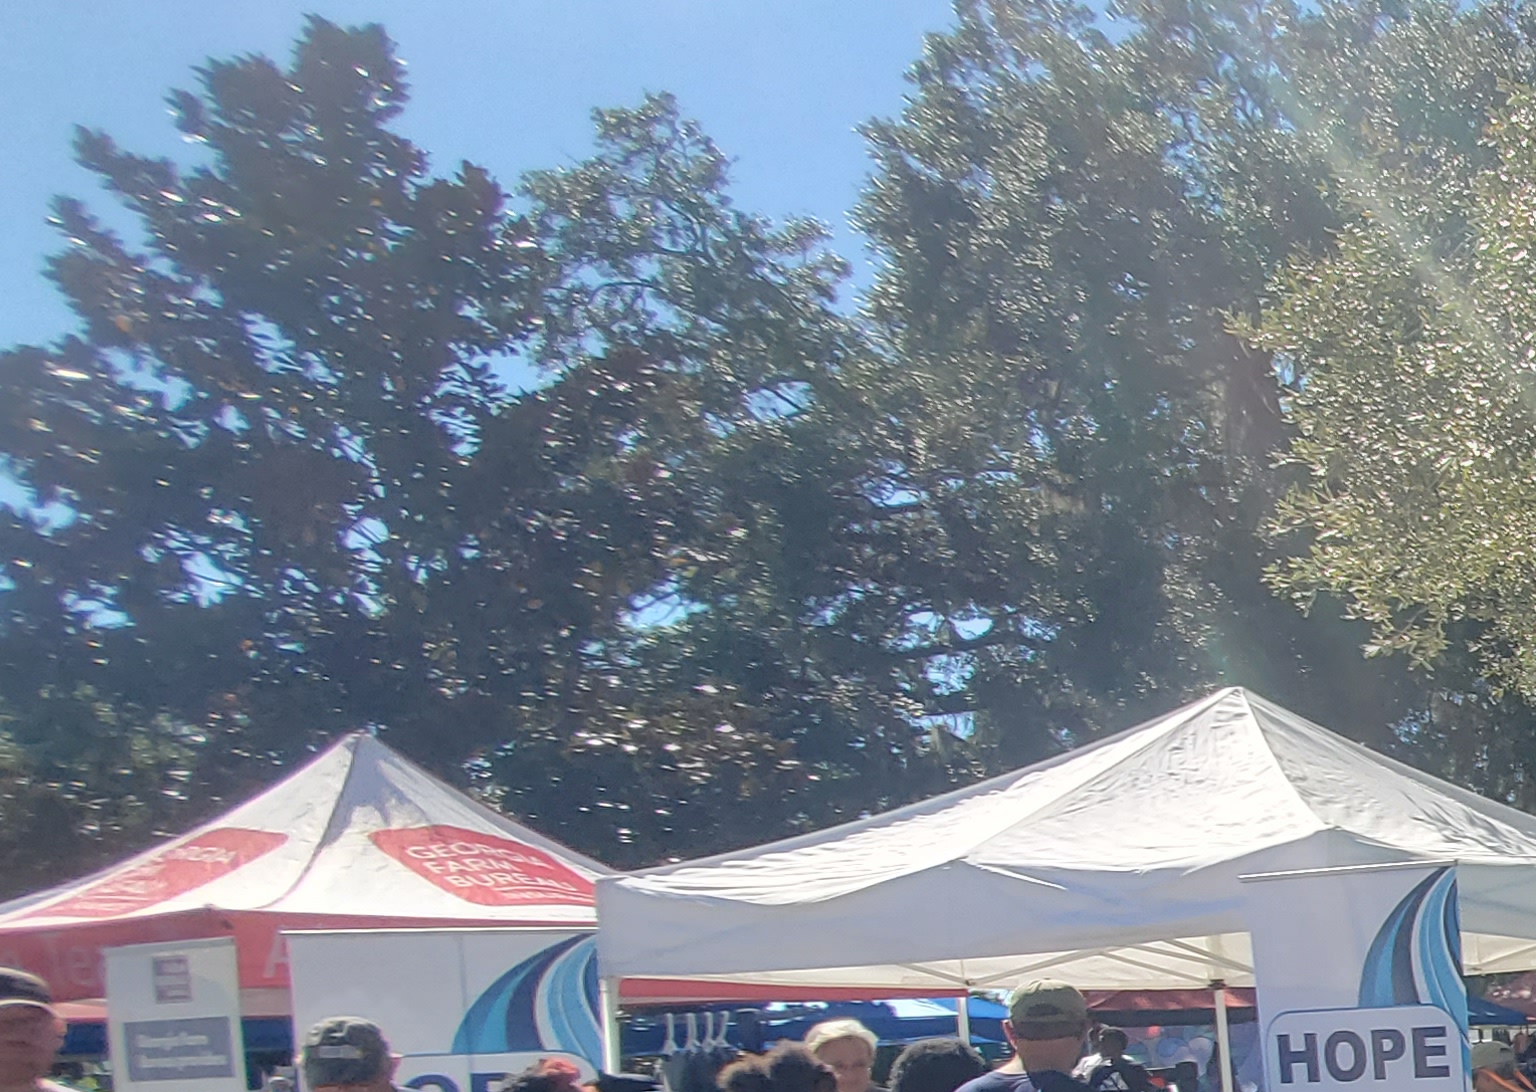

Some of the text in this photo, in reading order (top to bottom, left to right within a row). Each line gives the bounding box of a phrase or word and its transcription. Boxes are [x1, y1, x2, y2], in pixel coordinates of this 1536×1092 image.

[406, 841, 554, 870] GEORGIA
[423, 857, 523, 875] FARM
[444, 873, 579, 892] BUREAU
[1277, 1025, 1451, 1085] HOPE
